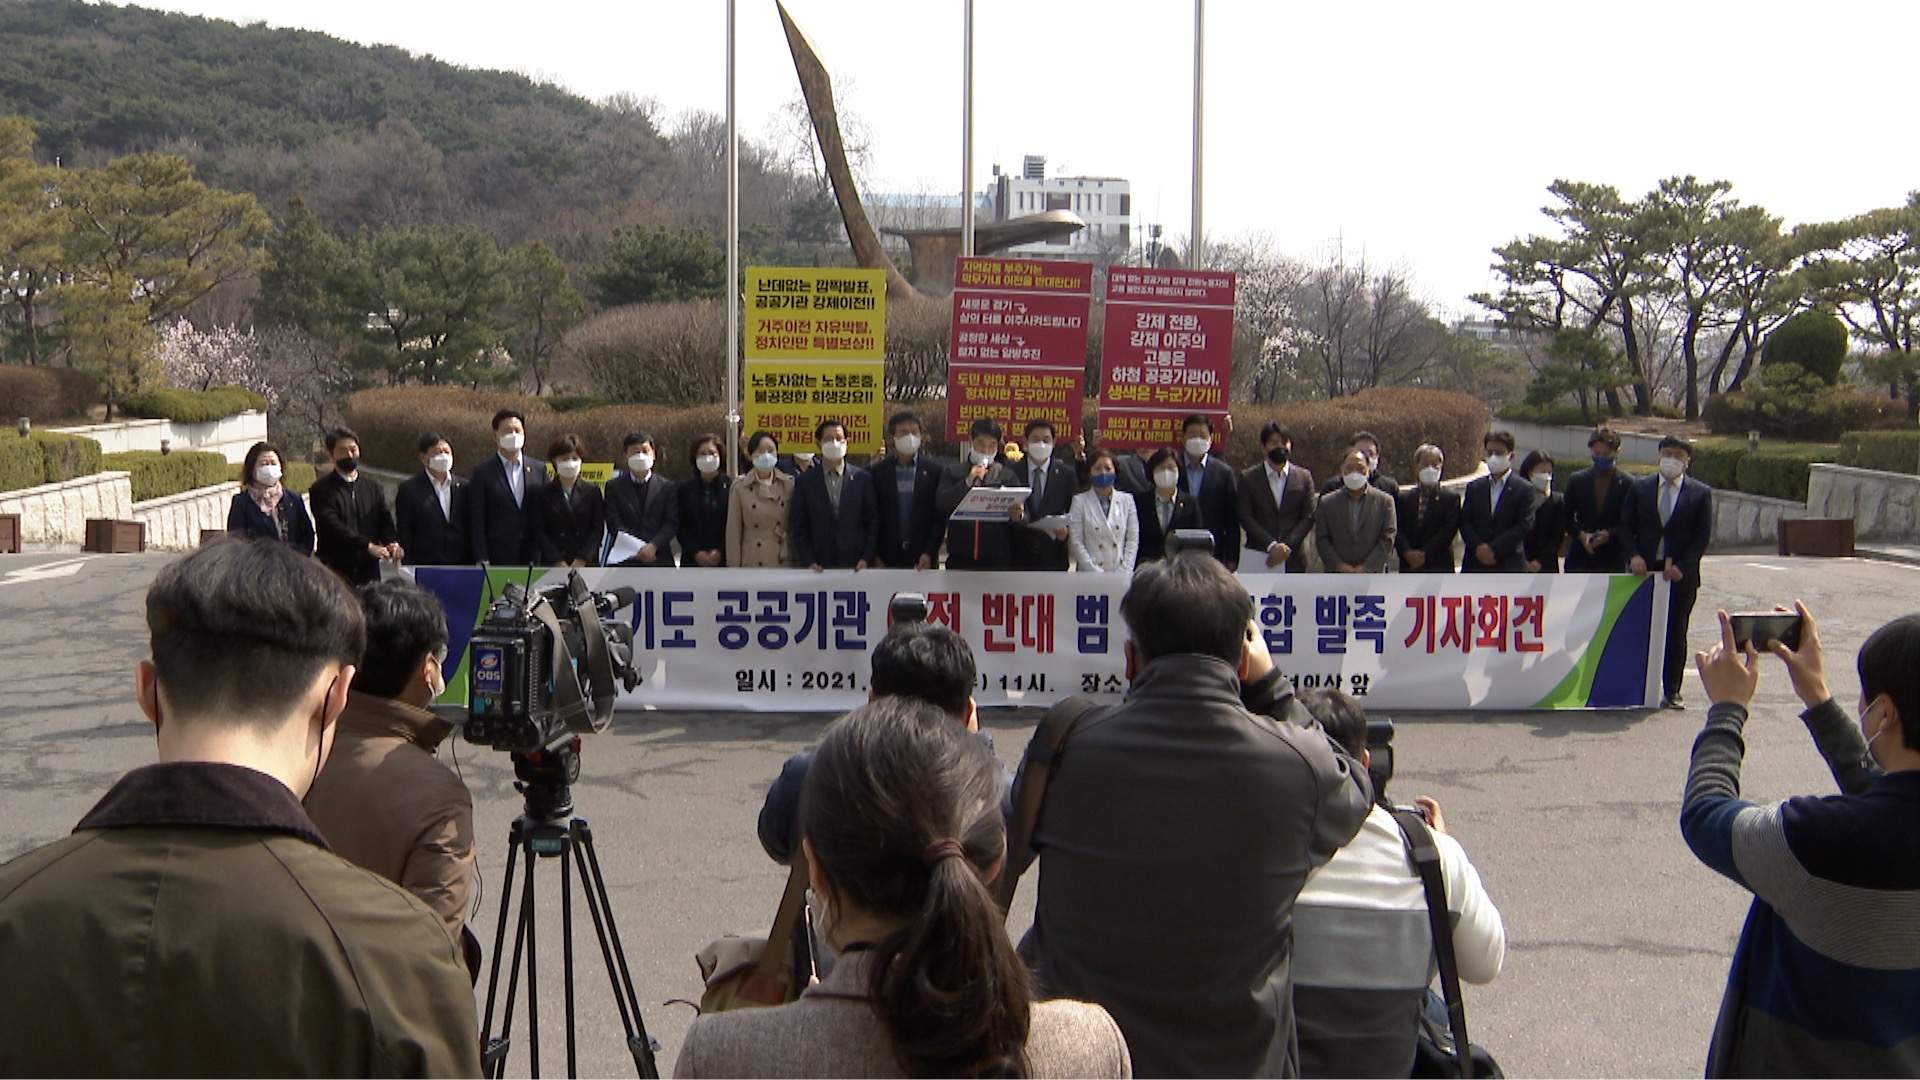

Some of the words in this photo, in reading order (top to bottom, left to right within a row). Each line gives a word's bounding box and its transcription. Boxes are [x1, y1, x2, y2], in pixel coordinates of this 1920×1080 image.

[1004, 262, 1042, 275] 부추기는
[758, 279, 811, 292] 난데없는
[816, 279, 872, 294] 깜짝발표,
[1004, 275, 1032, 287] 이전을
[756, 295, 808, 309] 공공기관
[813, 296, 875, 310] 강제이전!!
[960, 298, 991, 310] 새로운
[993, 299, 1012, 311] 경기
[758, 320, 811, 334] 거주이전
[815, 320, 872, 334] 자유박탈,
[982, 314, 1002, 325] 터를
[1005, 315, 1081, 328] 이주시켜드립니다
[1136, 313, 1166, 329] 강제
[1169, 315, 1201, 332] 전환,
[755, 336, 808, 350] 정치인만
[813, 336, 874, 350] 특별보상!!
[1130, 331, 1159, 347] 강제
[1163, 332, 1206, 350] 이주의
[1002, 348, 1040, 360] 일방추진
[1144, 350, 1186, 366] 고통은
[752, 374, 816, 388] 노동자없는
[822, 374, 877, 388] 노동존중,
[958, 373, 980, 385] 도민
[984, 374, 1006, 386] 위한
[1010, 375, 1075, 388] 공공노동자는
[1112, 367, 1141, 383] 하청
[1144, 368, 1220, 386] 공공기관이,
[755, 390, 808, 404] 불공정한
[812, 390, 873, 404] 희생강요!!
[966, 387, 1011, 400] 정치위한
[1014, 388, 1066, 402] 도구인가!!
[1108, 385, 1151, 401] 생색은
[1155, 386, 1221, 403] 누군가가!!
[960, 405, 1012, 420] 반민주적
[758, 414, 809, 428] 검증없는
[716, 591, 870, 651] 공공기관
[982, 593, 1055, 654] 반대
[1076, 594, 1109, 654] 범
[1315, 595, 1387, 654] 발족
[1404, 594, 1545, 654] 기자회견
[736, 669, 776, 692] 일시
[787, 673, 792, 687] :
[802, 671, 867, 692] 2021.
[1000, 673, 1055, 692] 11시.
[1081, 673, 1122, 694] 장소
[1351, 673, 1370, 696] 앞
